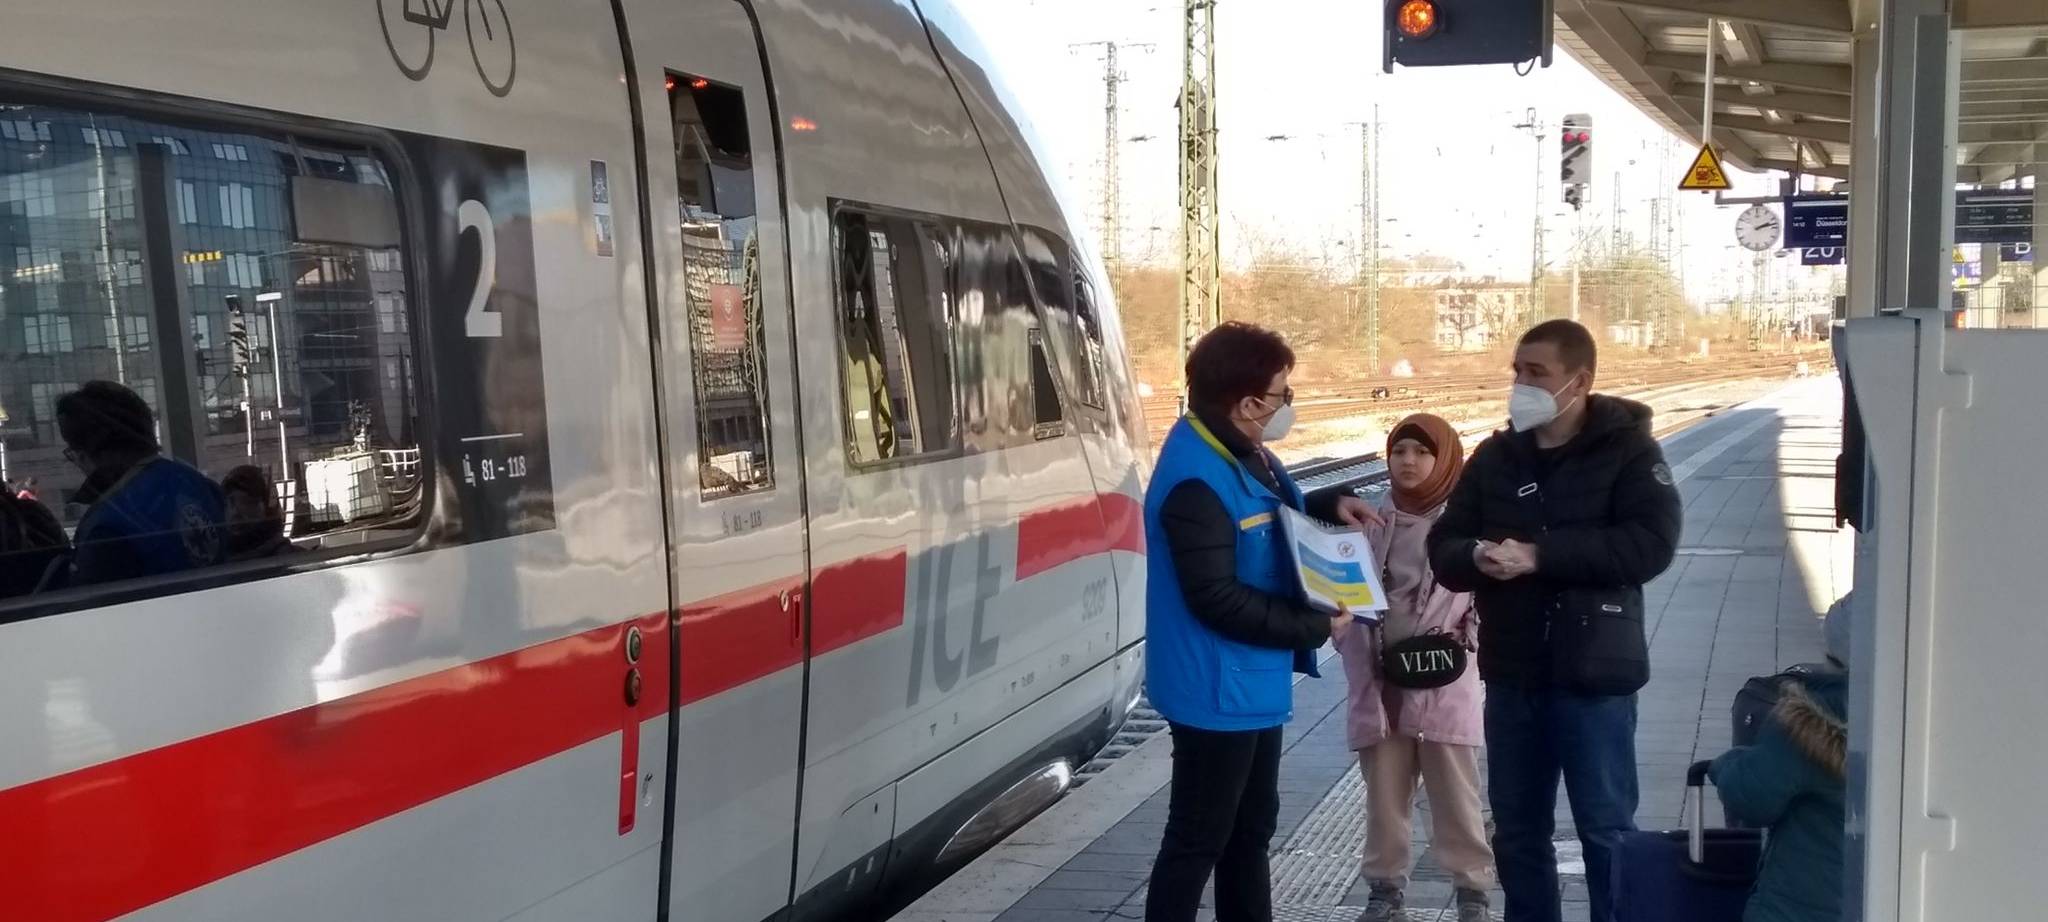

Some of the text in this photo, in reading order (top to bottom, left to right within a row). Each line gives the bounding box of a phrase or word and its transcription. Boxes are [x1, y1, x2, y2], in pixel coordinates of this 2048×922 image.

[459, 199, 503, 338] 2
[481, 459, 495, 480] 81
[507, 455, 526, 477] 118
[906, 507, 1002, 709] ICE
[1400, 649, 1455, 674] VLTN
